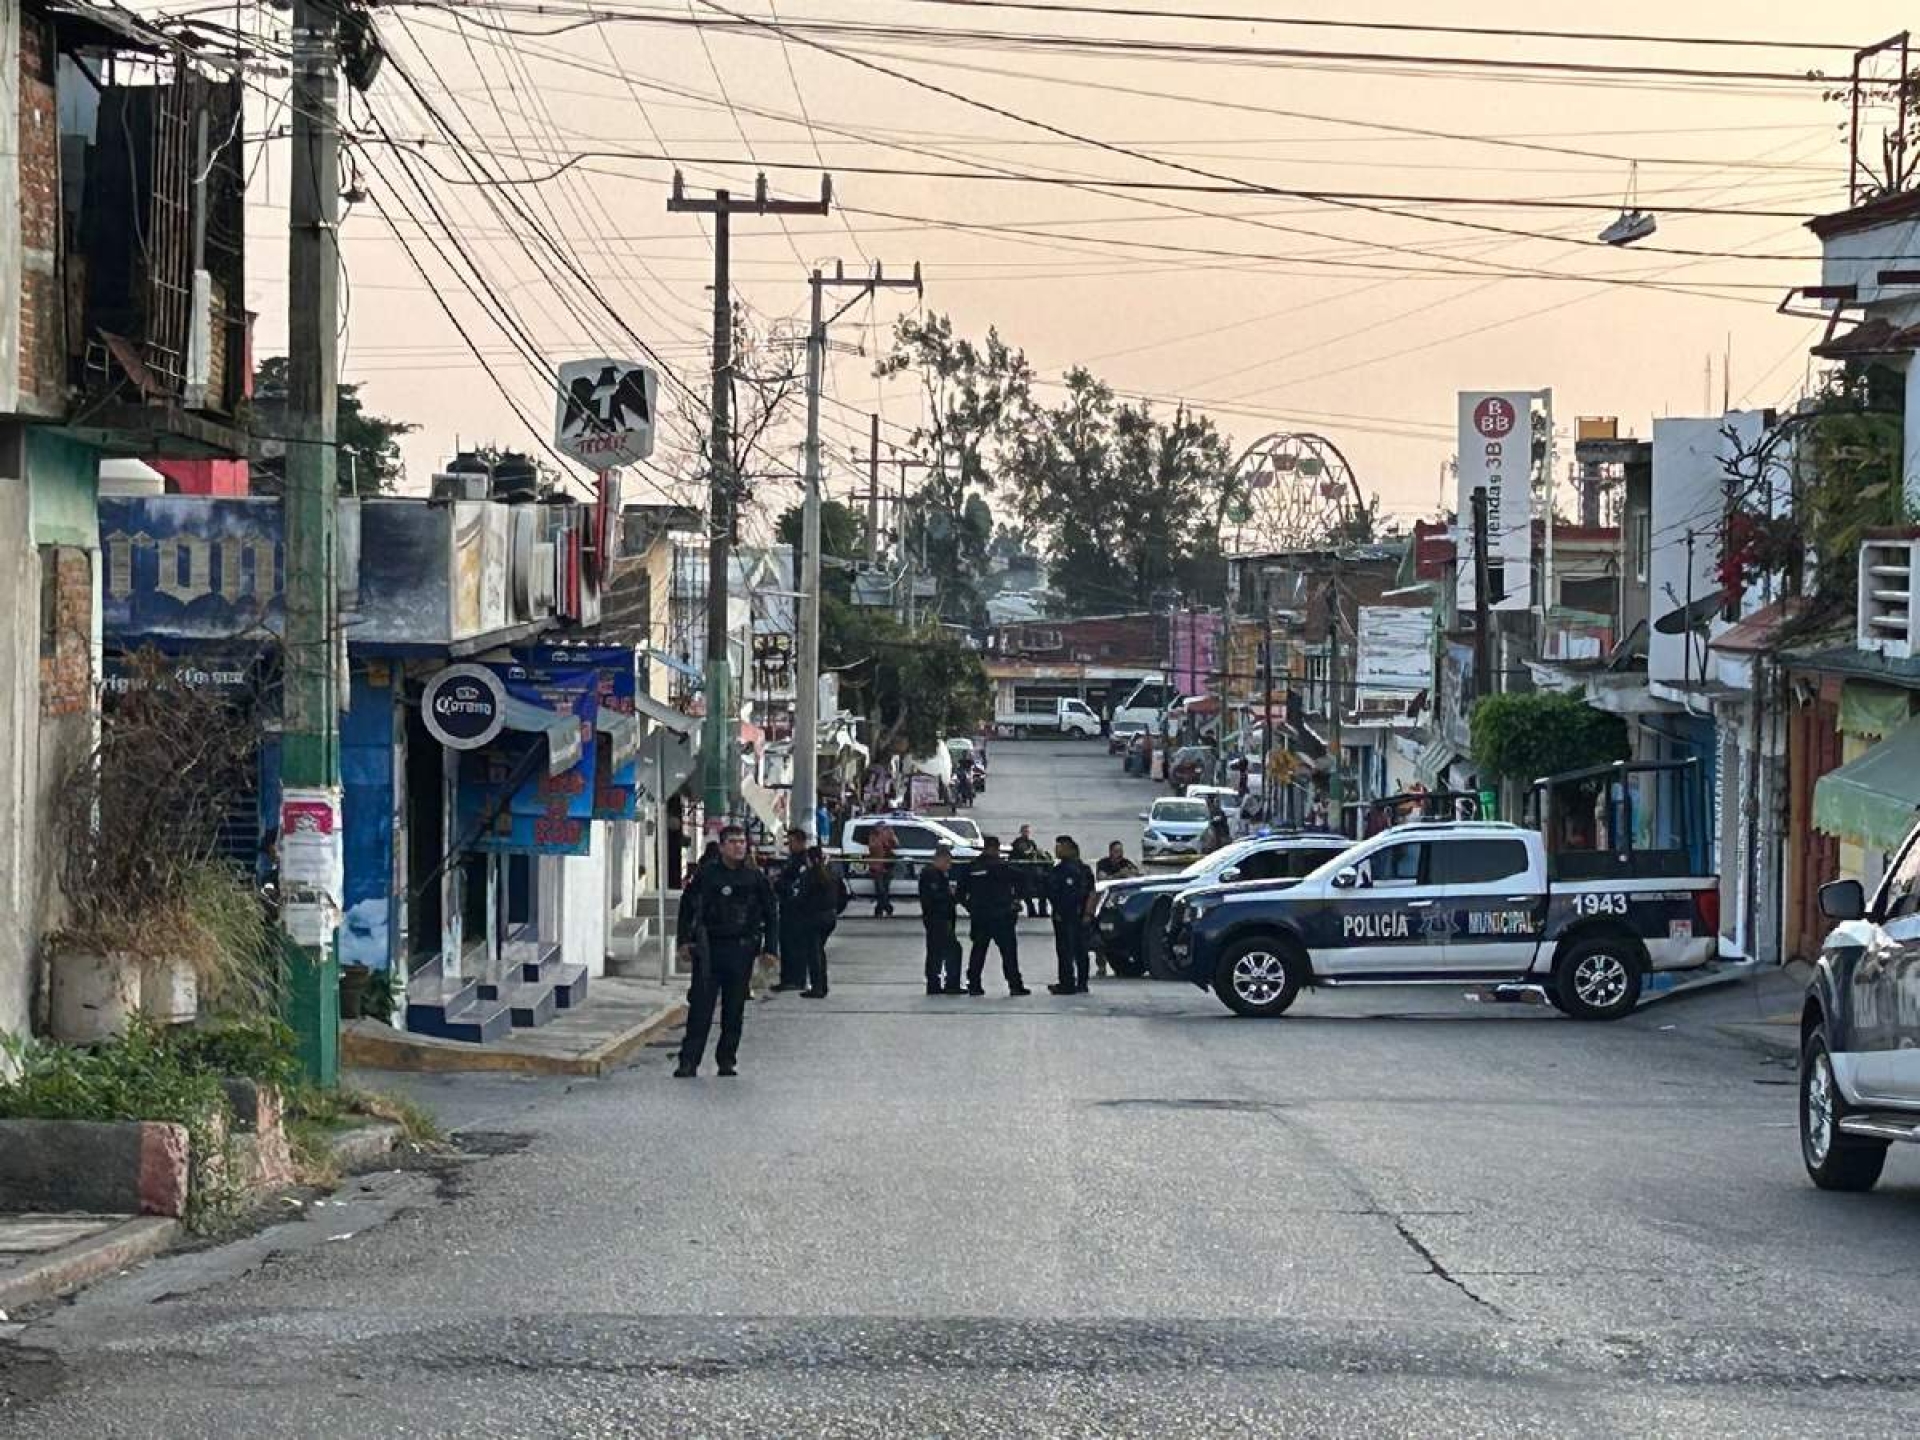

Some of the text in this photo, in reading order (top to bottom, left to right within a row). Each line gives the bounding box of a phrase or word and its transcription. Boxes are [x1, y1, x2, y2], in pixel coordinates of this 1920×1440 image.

[1485, 442, 1502, 469] 3B
[104, 528, 286, 606] ron
[1572, 893, 1629, 916] 1943
